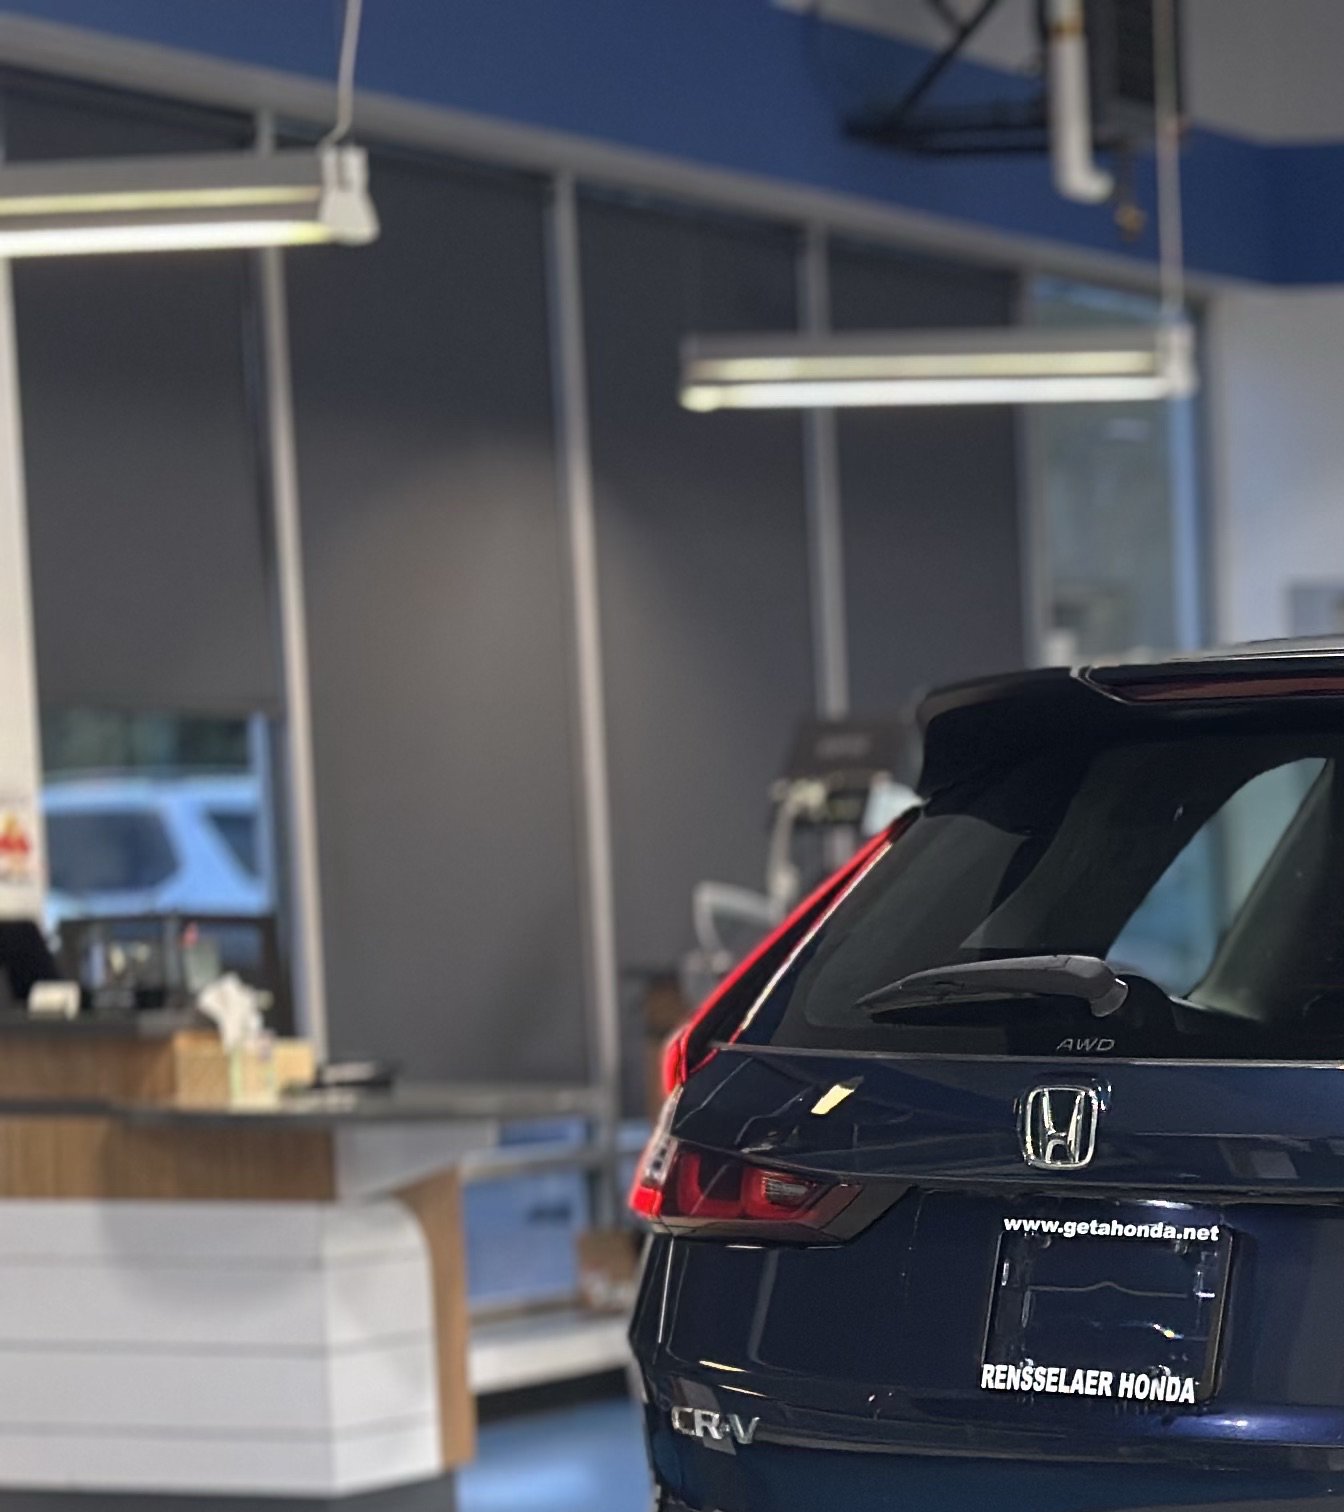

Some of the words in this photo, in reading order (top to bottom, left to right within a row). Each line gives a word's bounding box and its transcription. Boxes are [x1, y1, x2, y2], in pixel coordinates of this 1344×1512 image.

[1056, 1037, 1115, 1052] AWD
[1003, 1217, 1219, 1241] www.getahonda.net
[981, 1364, 1113, 1397] RENSSELAER
[1118, 1372, 1195, 1403] HONDA
[671, 1406, 761, 1444] CR-V
